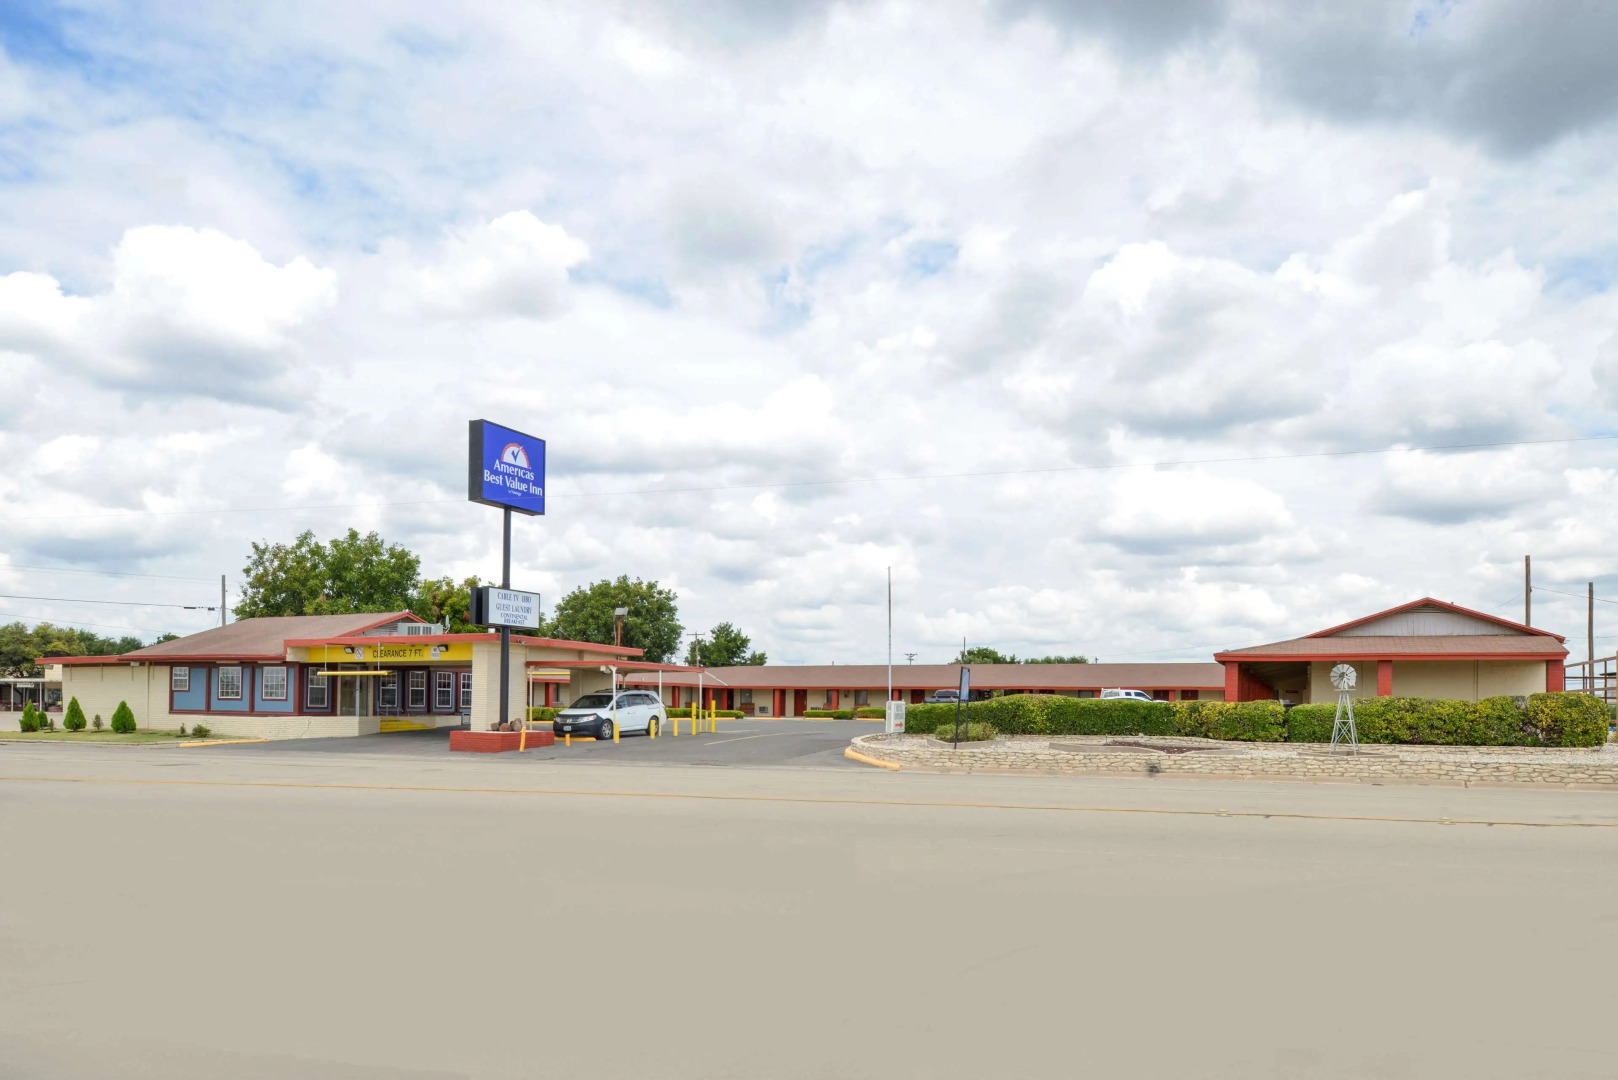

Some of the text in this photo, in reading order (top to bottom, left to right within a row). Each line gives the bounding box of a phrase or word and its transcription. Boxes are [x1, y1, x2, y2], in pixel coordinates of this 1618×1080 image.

[494, 459, 534, 480] Americas
[484, 469, 503, 486] Best
[505, 475, 528, 492] Value
[530, 482, 542, 496] Inn
[498, 592, 532, 604] CABLE TV HBO
[496, 603, 532, 614] GUEST LAUNDRY
[373, 649, 406, 658] CLEARANCE
